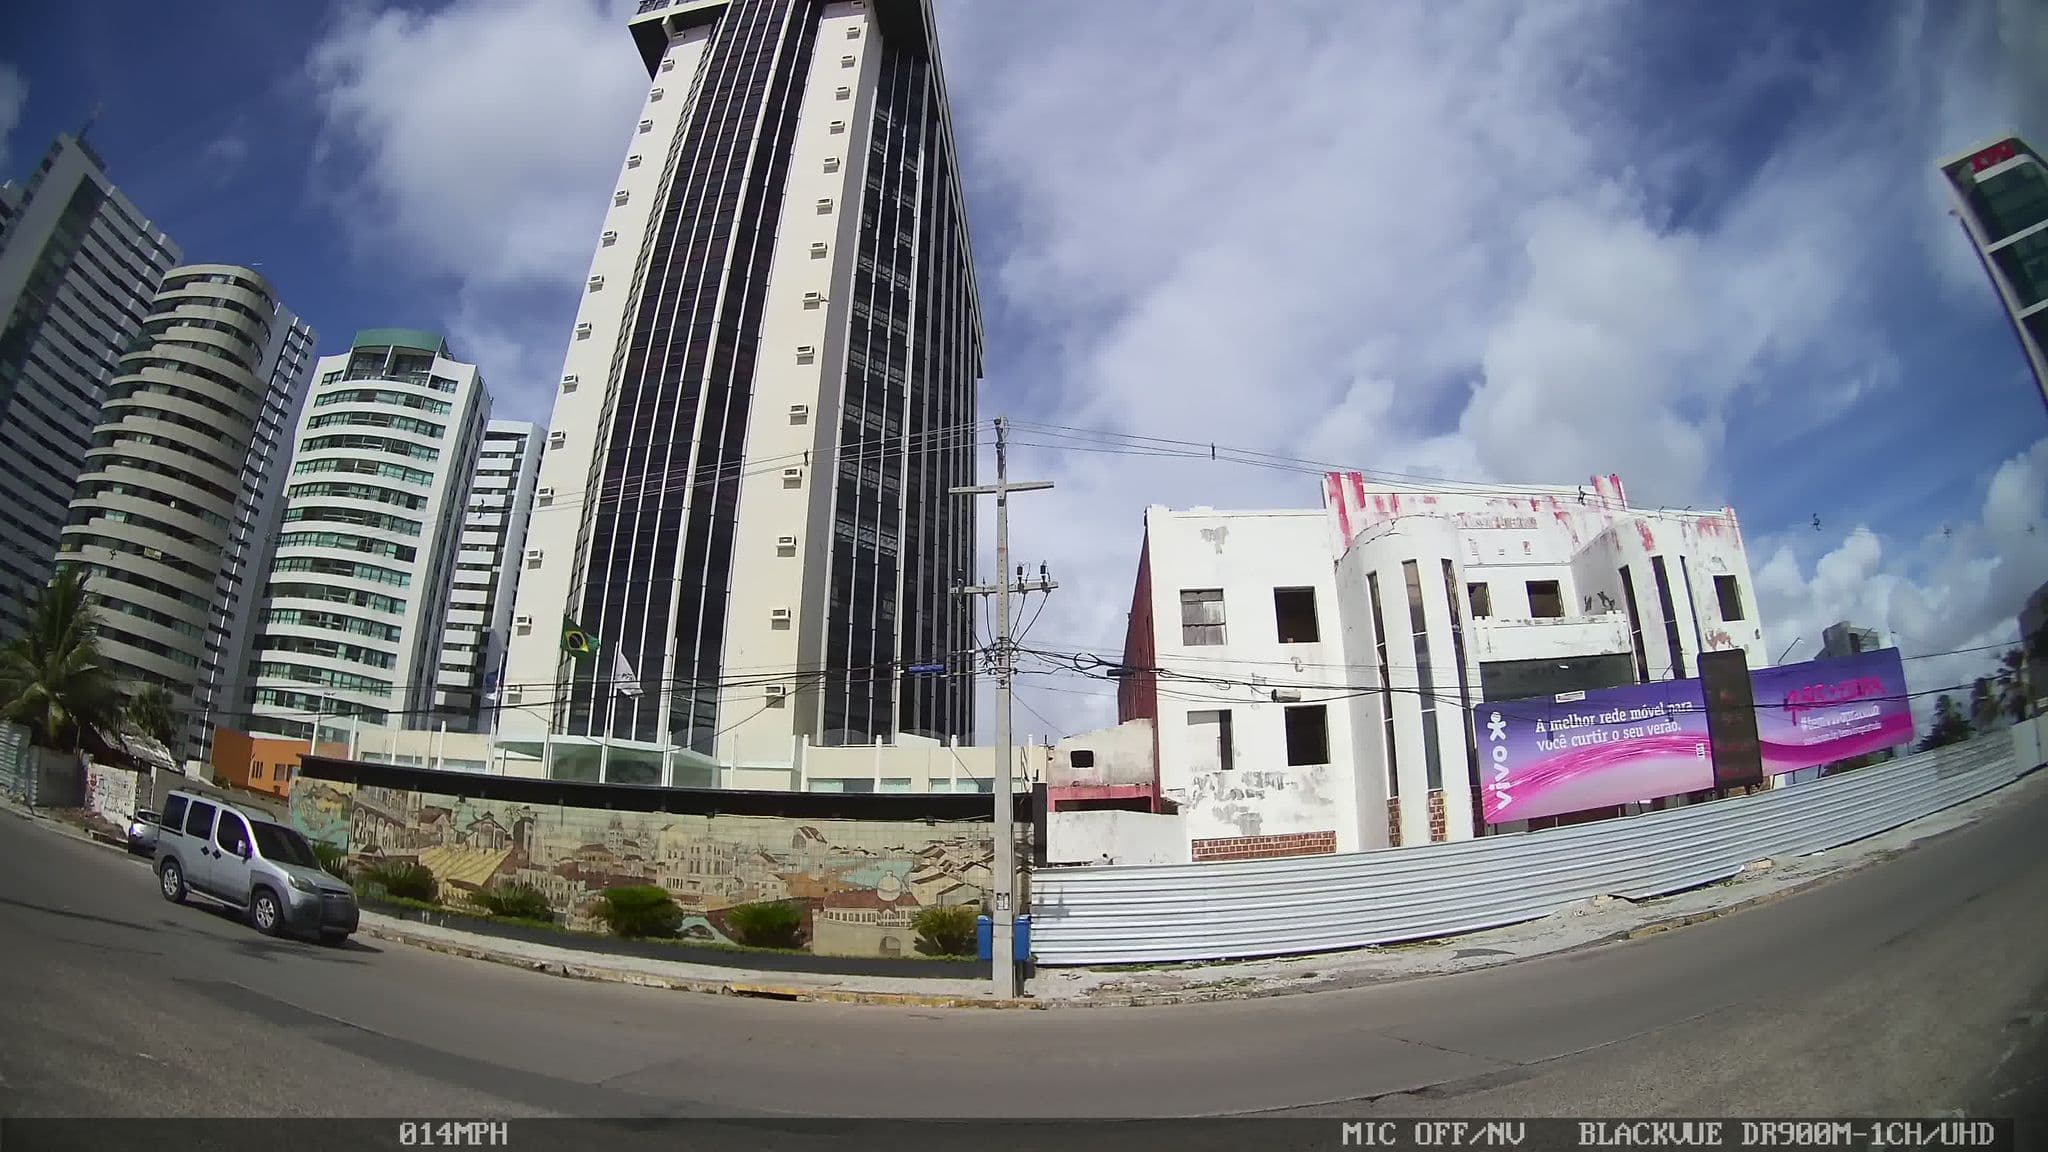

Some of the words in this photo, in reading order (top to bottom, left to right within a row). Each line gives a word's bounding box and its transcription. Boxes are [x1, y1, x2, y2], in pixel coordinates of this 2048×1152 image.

[1550, 713, 1596, 732] melhor
[1599, 708, 1626, 724] rede
[1629, 702, 1665, 720] móvel
[1667, 701, 1693, 716] para
[1536, 734, 1567, 751] você
[1571, 729, 1608, 747] curtir
[1612, 730, 1620, 741] o
[1623, 726, 1644, 739] seu
[1647, 718, 1682, 736] verão.
[1489, 745, 1512, 810] vivo
